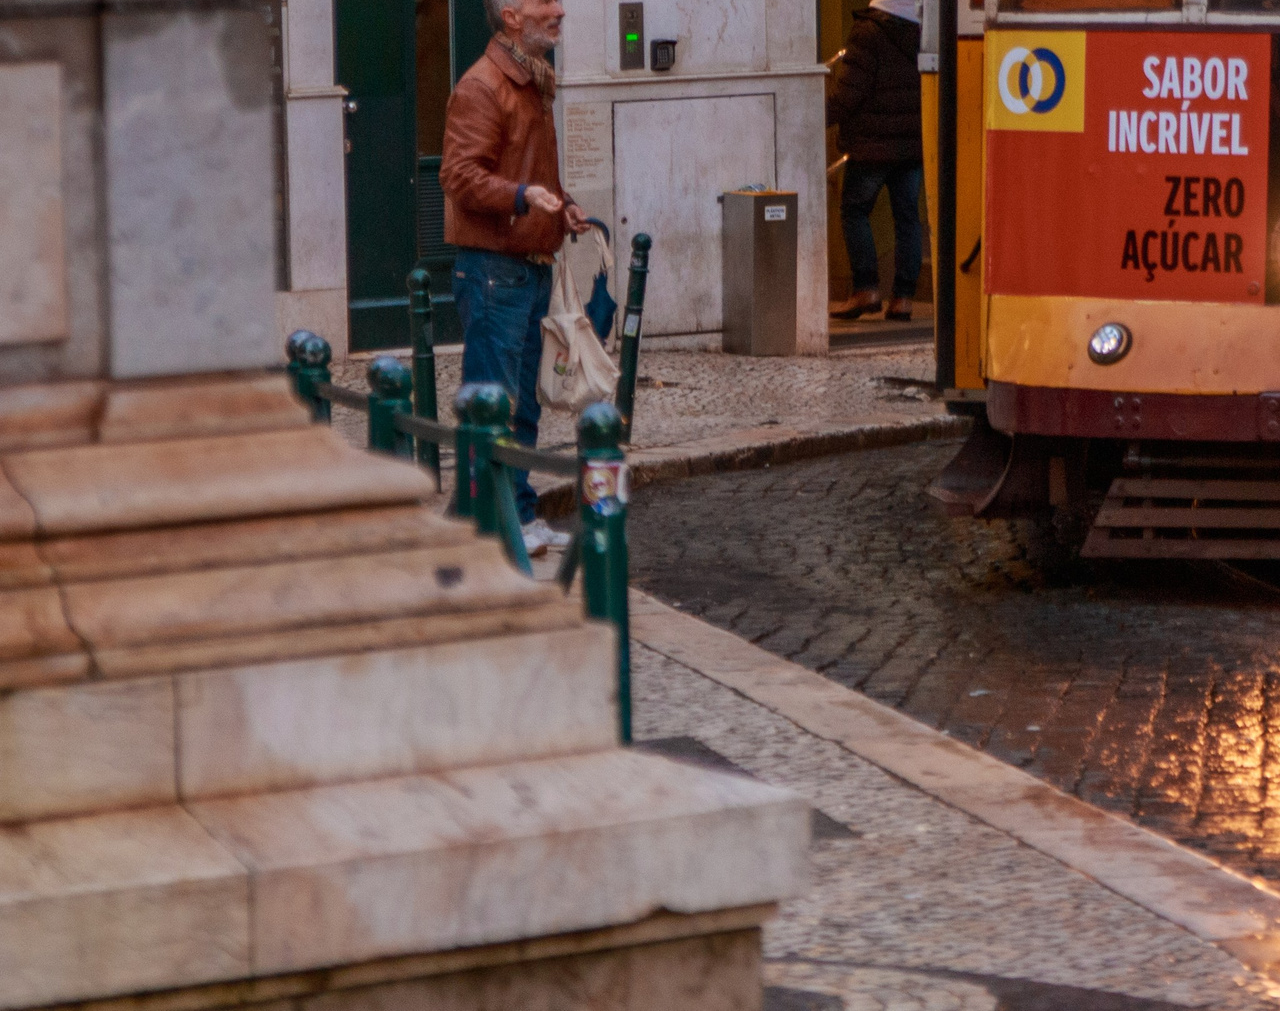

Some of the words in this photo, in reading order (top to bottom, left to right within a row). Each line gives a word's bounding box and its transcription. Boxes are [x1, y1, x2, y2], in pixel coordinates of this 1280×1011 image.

[1142, 56, 1248, 100] SABOR
[1108, 100, 1249, 155] INCRÍVEL
[1164, 176, 1245, 218] ZERO
[1121, 219, 1244, 282] AÇÚCAR
